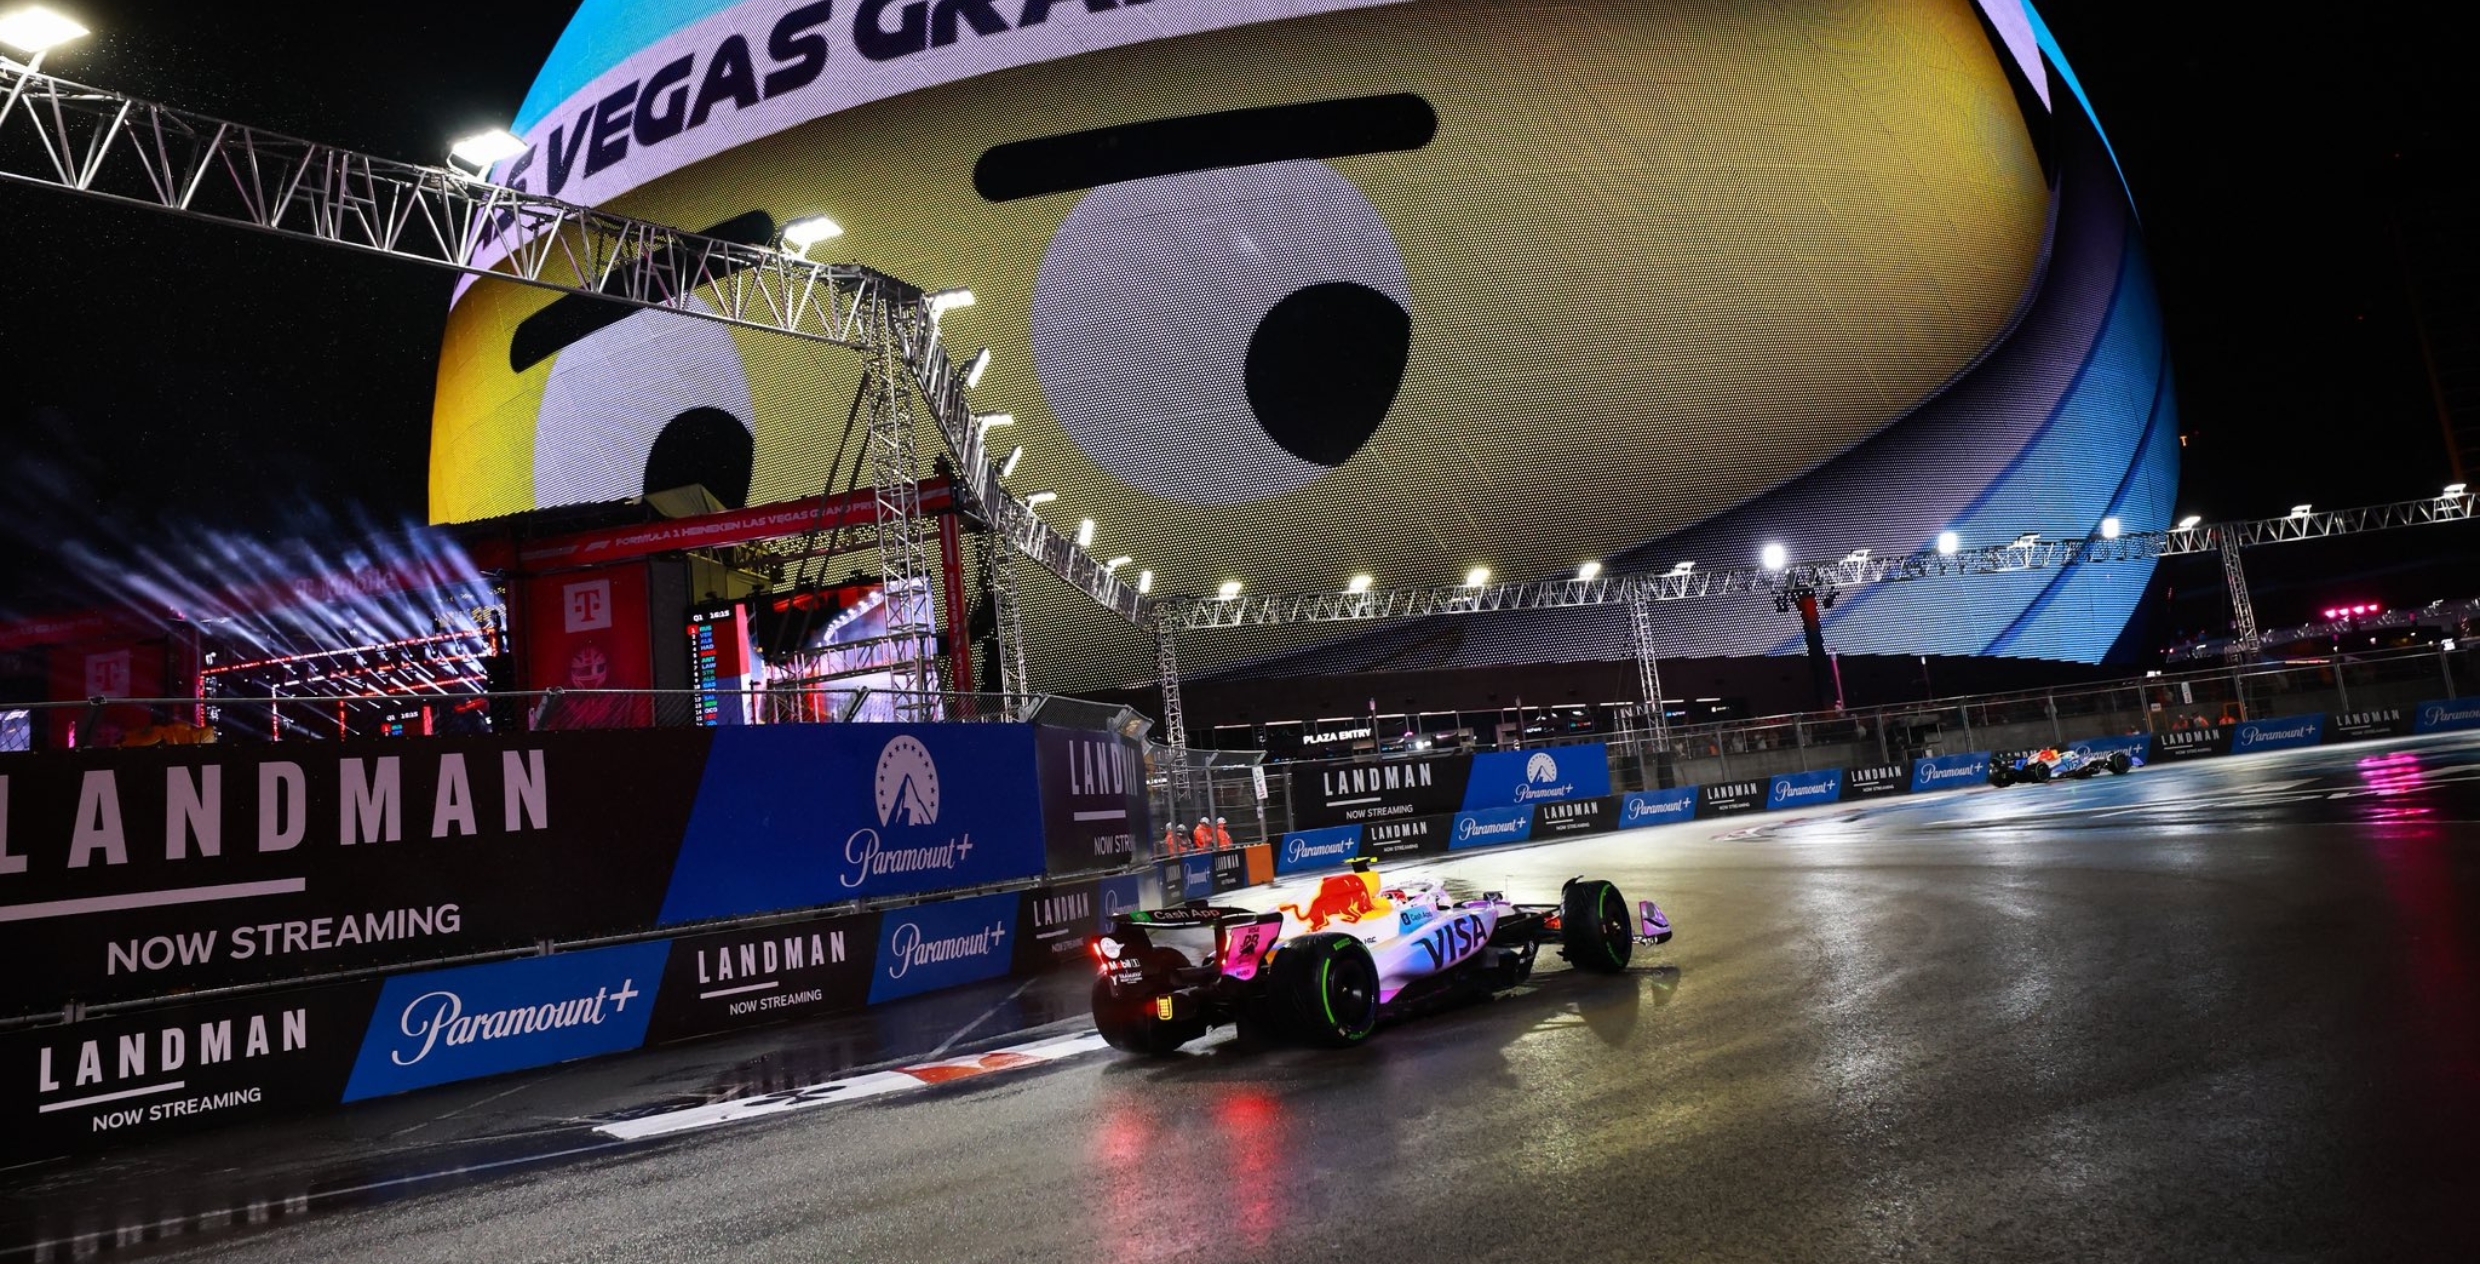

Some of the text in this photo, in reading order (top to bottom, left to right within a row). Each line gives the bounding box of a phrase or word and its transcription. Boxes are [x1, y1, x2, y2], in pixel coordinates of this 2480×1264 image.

[547, 0, 833, 196] VEGAS
[615, 531, 671, 547] FORMULA
[682, 521, 740, 537] HEINEKEN
[743, 517, 766, 528] LAS
[768, 511, 809, 524] VEGAS
[810, 504, 851, 518] GAN
[2336, 709, 2400, 727] LANDMAN
[1303, 728, 1372, 745] PLAZA ENTRY
[2161, 728, 2220, 746] LANDMAN
[2241, 724, 2315, 746] Paramount+
[1069, 740, 1138, 796] LANDM
[1323, 763, 1432, 796] LANDMAN
[1851, 765, 1902, 783] LANDMAN
[1919, 762, 1983, 784] Paramount+
[1706, 783, 1757, 800] LANDMAN
[1774, 779, 1836, 801] Paramount+
[0, 749, 548, 874] LANDMAN
[1346, 804, 1413, 820] NOW STREAMING
[1543, 801, 1598, 820] LANDMAN
[1628, 797, 1691, 820] Paramount+
[1370, 821, 1428, 841] LANDMAN
[1458, 817, 1526, 841] Paramount+
[840, 828, 973, 888] Paramount+
[1094, 836, 1113, 856] NOW
[1287, 837, 1355, 863] Paramount+
[1033, 892, 1090, 927] LANDMAN
[1153, 908, 1220, 920] Cash App
[107, 903, 461, 975] NOW STREAMING
[889, 920, 1005, 979] Paramount+
[1410, 914, 1488, 970] VISA
[698, 930, 845, 984] LANDMAN
[1109, 958, 1131, 970] Mobil
[729, 988, 822, 1016] NOW STREAMING
[391, 978, 638, 1066] Paramount+
[39, 1008, 306, 1093] LANDMAN
[93, 1087, 261, 1132] NOW STREAMING
